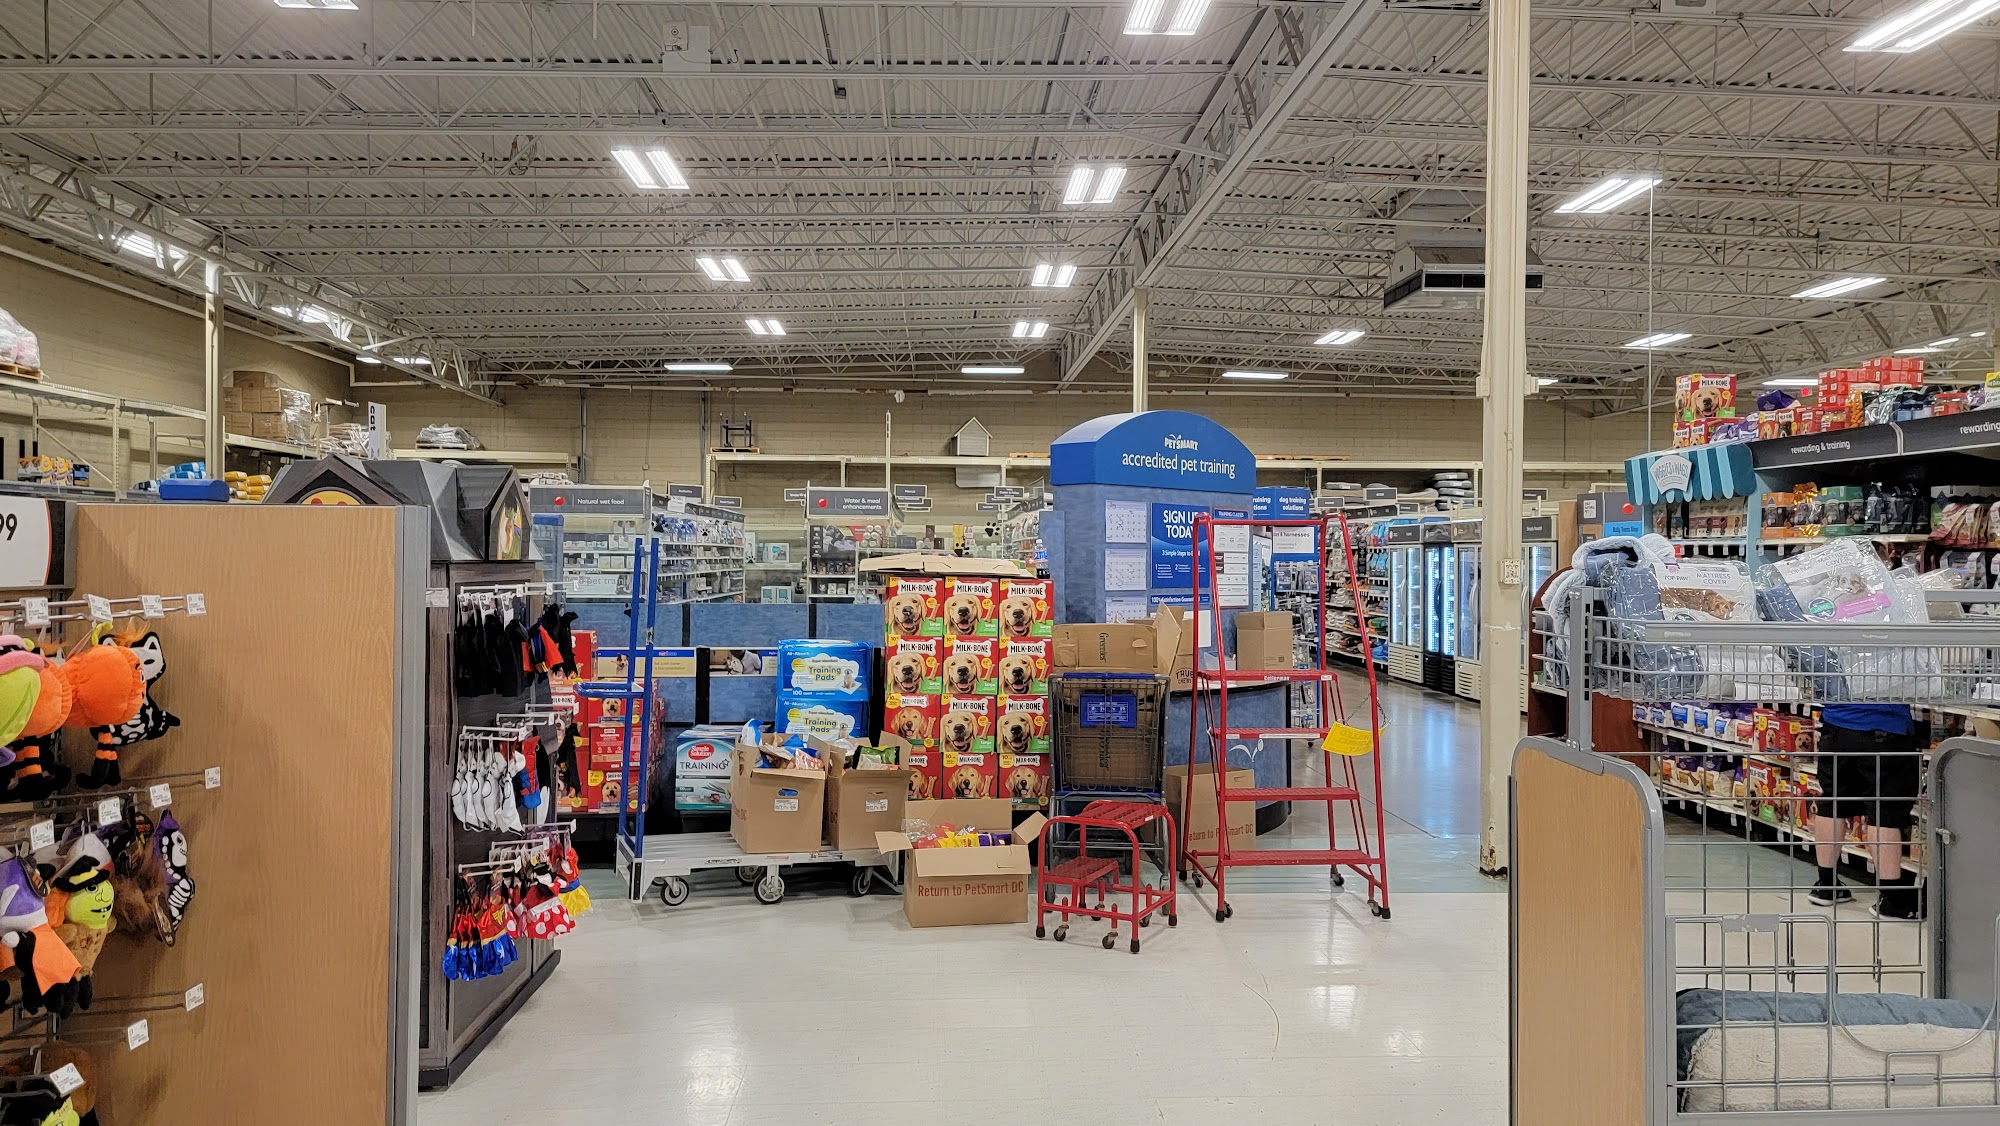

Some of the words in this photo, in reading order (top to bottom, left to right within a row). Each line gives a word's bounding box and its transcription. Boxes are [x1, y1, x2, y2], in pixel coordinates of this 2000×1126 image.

[1164, 436, 1198, 450] PETSMART
[1791, 444, 1820, 455] rewarding
[1826, 440, 1850, 452] training
[1122, 452, 1178, 470] accredited
[1181, 458, 1197, 475] pet
[1200, 458, 1236, 479] training
[1164, 510, 1185, 524] SIGN
[804, 718, 837, 727] Training
[680, 762, 726, 770] TRAINING
[1189, 832, 1205, 841] eturn
[1208, 830, 1213, 838] to
[1245, 824, 1253, 833] DC
[918, 885, 949, 896] Return
[953, 885, 961, 896] to
[965, 882, 1009, 895] PetSmart
[1012, 881, 1024, 893] DC
